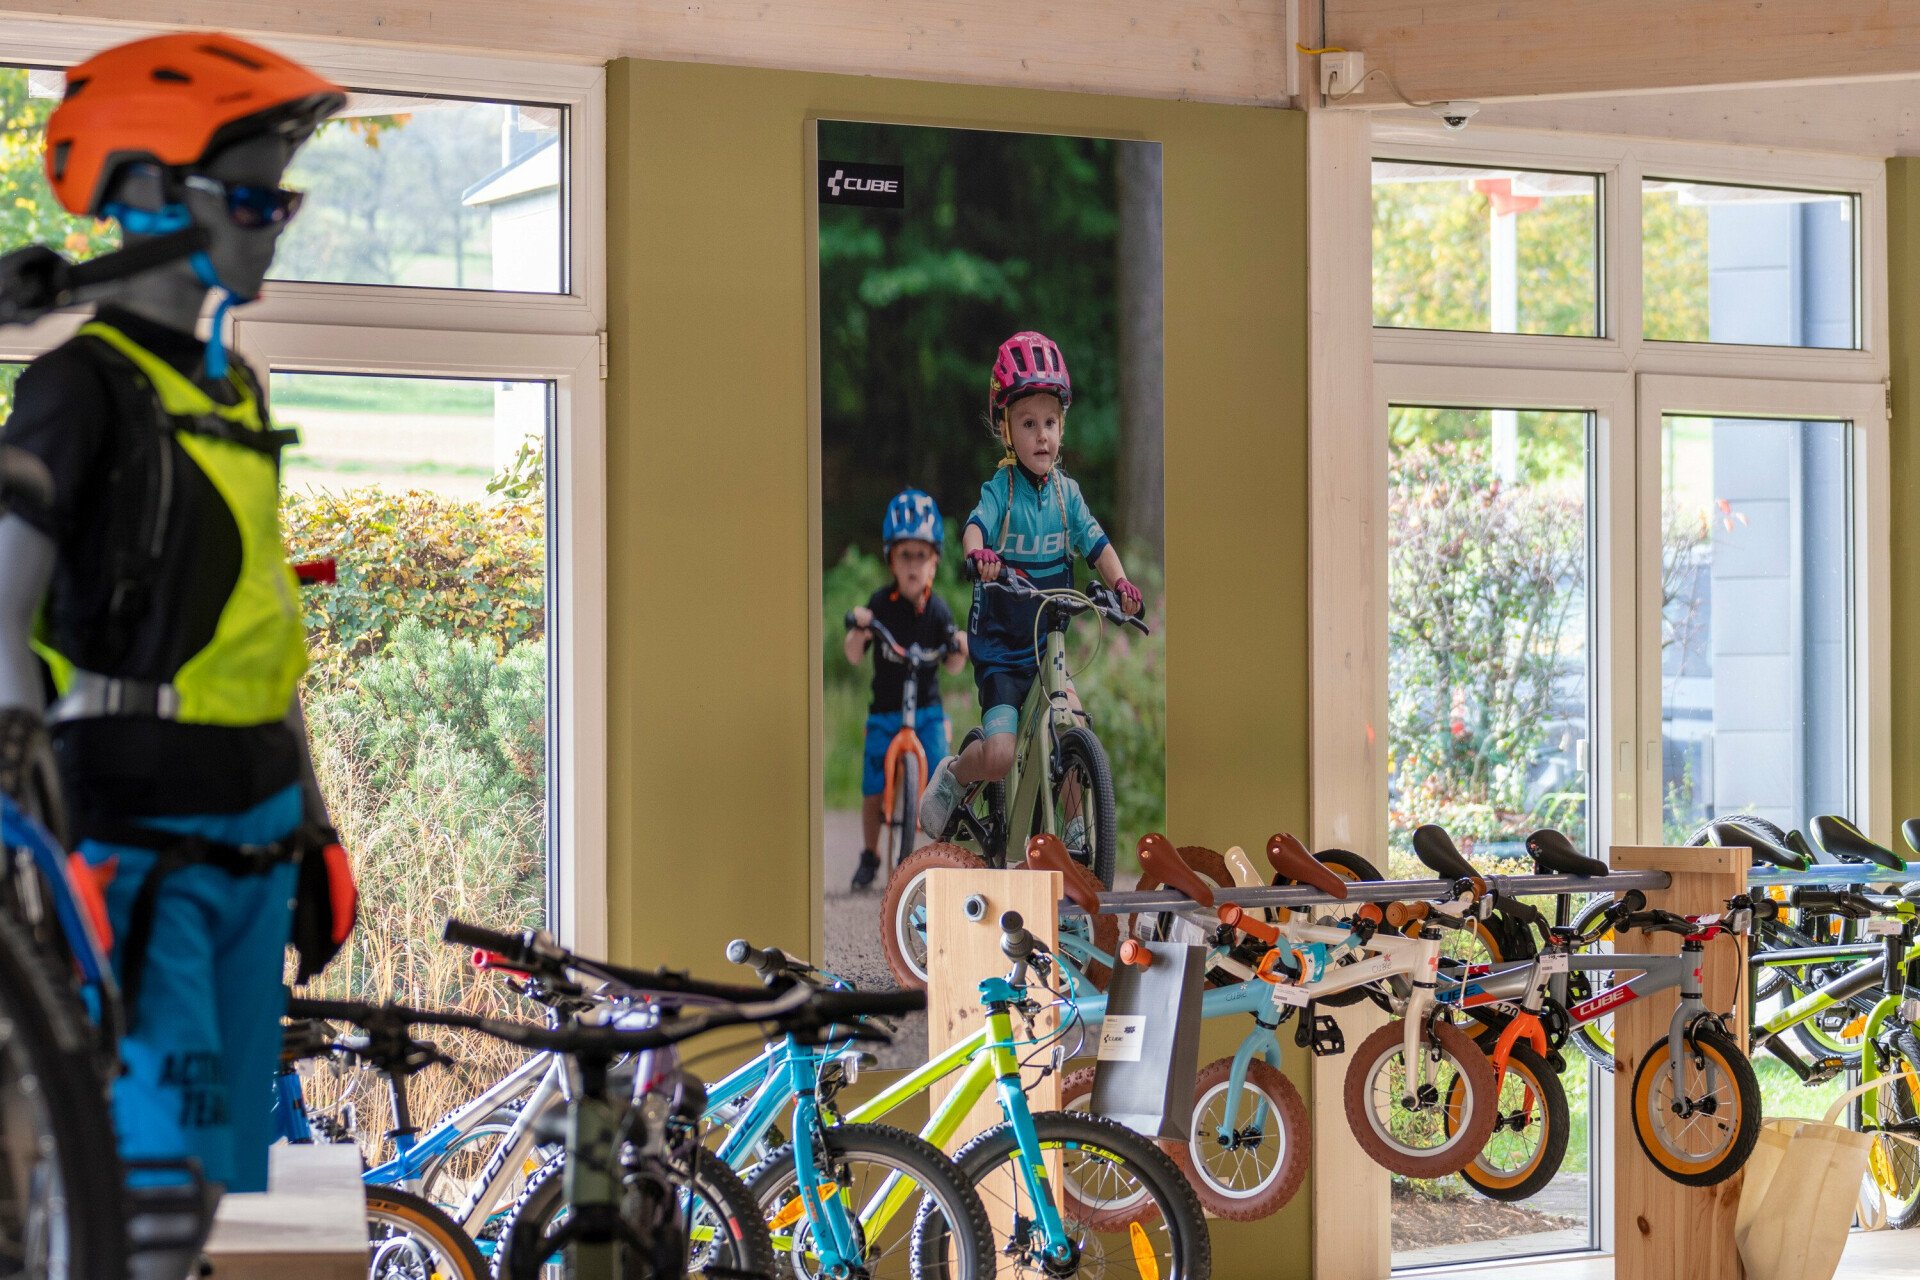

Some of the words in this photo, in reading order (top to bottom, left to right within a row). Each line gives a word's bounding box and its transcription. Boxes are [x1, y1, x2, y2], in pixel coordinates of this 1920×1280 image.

[843, 177, 898, 193] CUBE
[1003, 530, 1072, 555] CUB
[1435, 984, 1478, 1003] UBE
[1579, 988, 1625, 1016] CUBE
[1081, 1143, 1126, 1165] CUBE
[803, 1185, 819, 1223] CUBE
